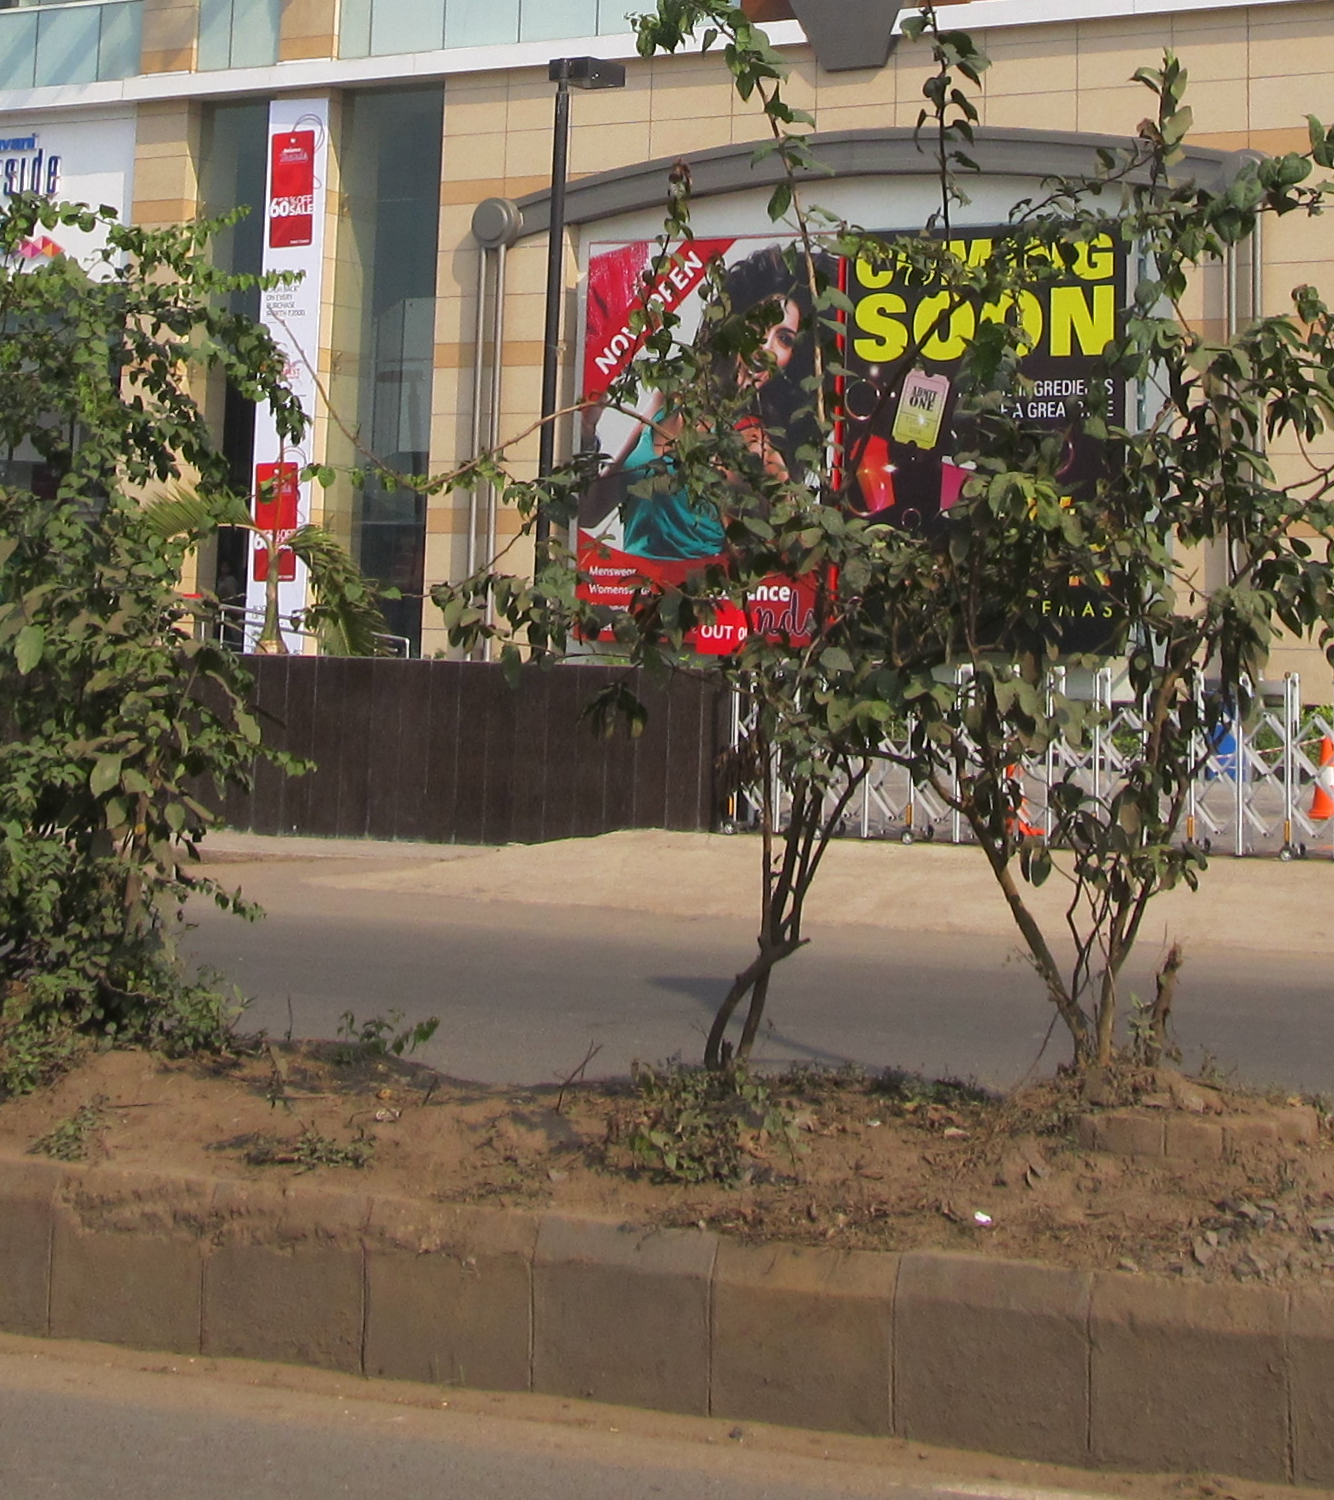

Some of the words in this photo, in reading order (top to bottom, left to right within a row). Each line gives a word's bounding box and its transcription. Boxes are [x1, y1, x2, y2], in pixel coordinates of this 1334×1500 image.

[269, 197, 289, 217] 60
[289, 203, 314, 216] SALE
[909, 396, 934, 412] ONE
[700, 625, 733, 640] OUT
